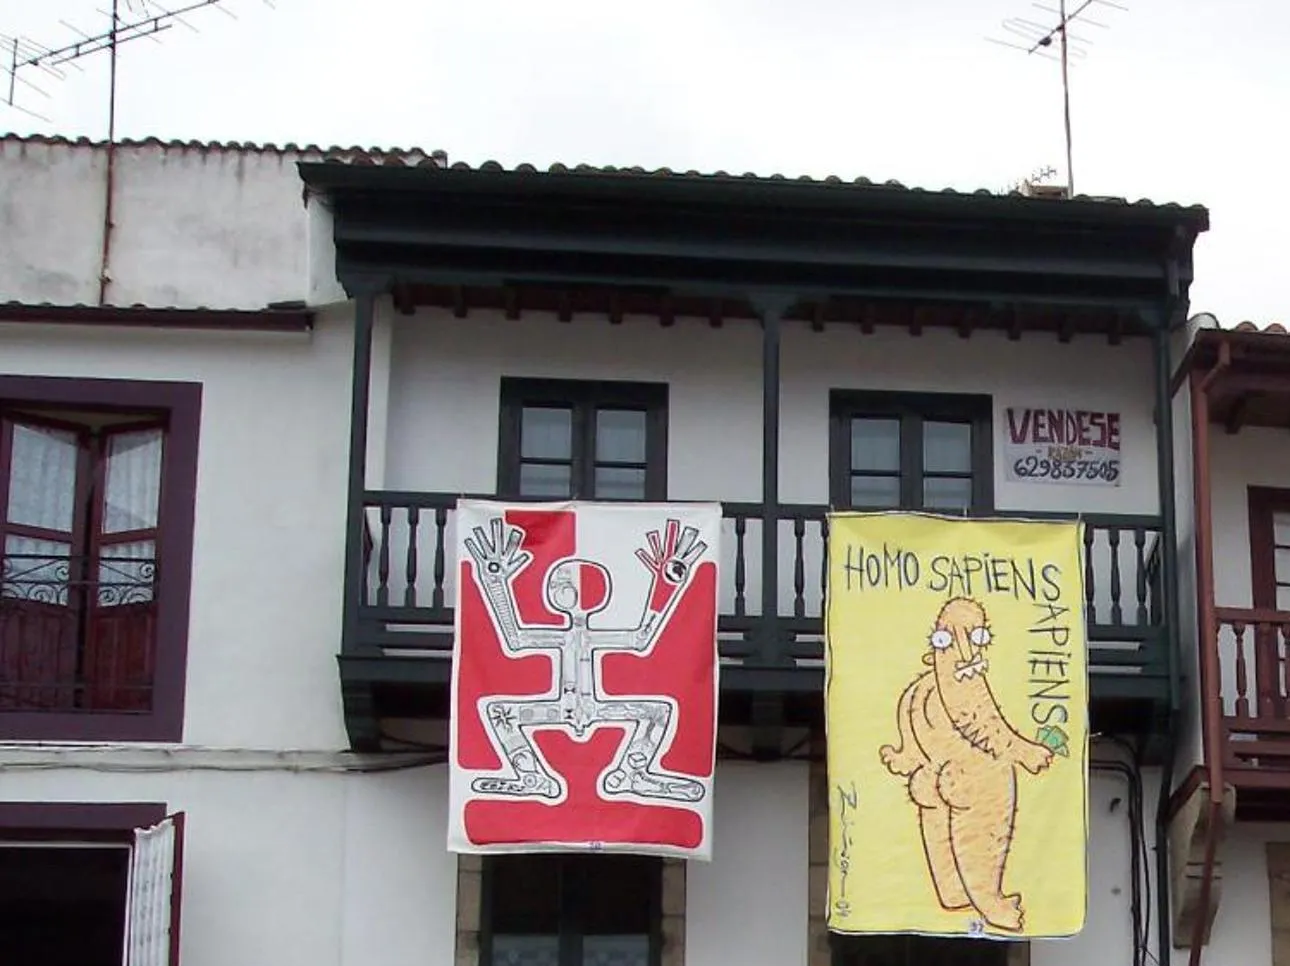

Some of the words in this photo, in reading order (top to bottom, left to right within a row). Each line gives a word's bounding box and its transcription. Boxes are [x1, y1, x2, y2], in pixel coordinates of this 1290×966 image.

[1007, 408, 1120, 451] VENDESE
[845, 543, 920, 592] HOMO
[929, 552, 1062, 601] SAPIENS
